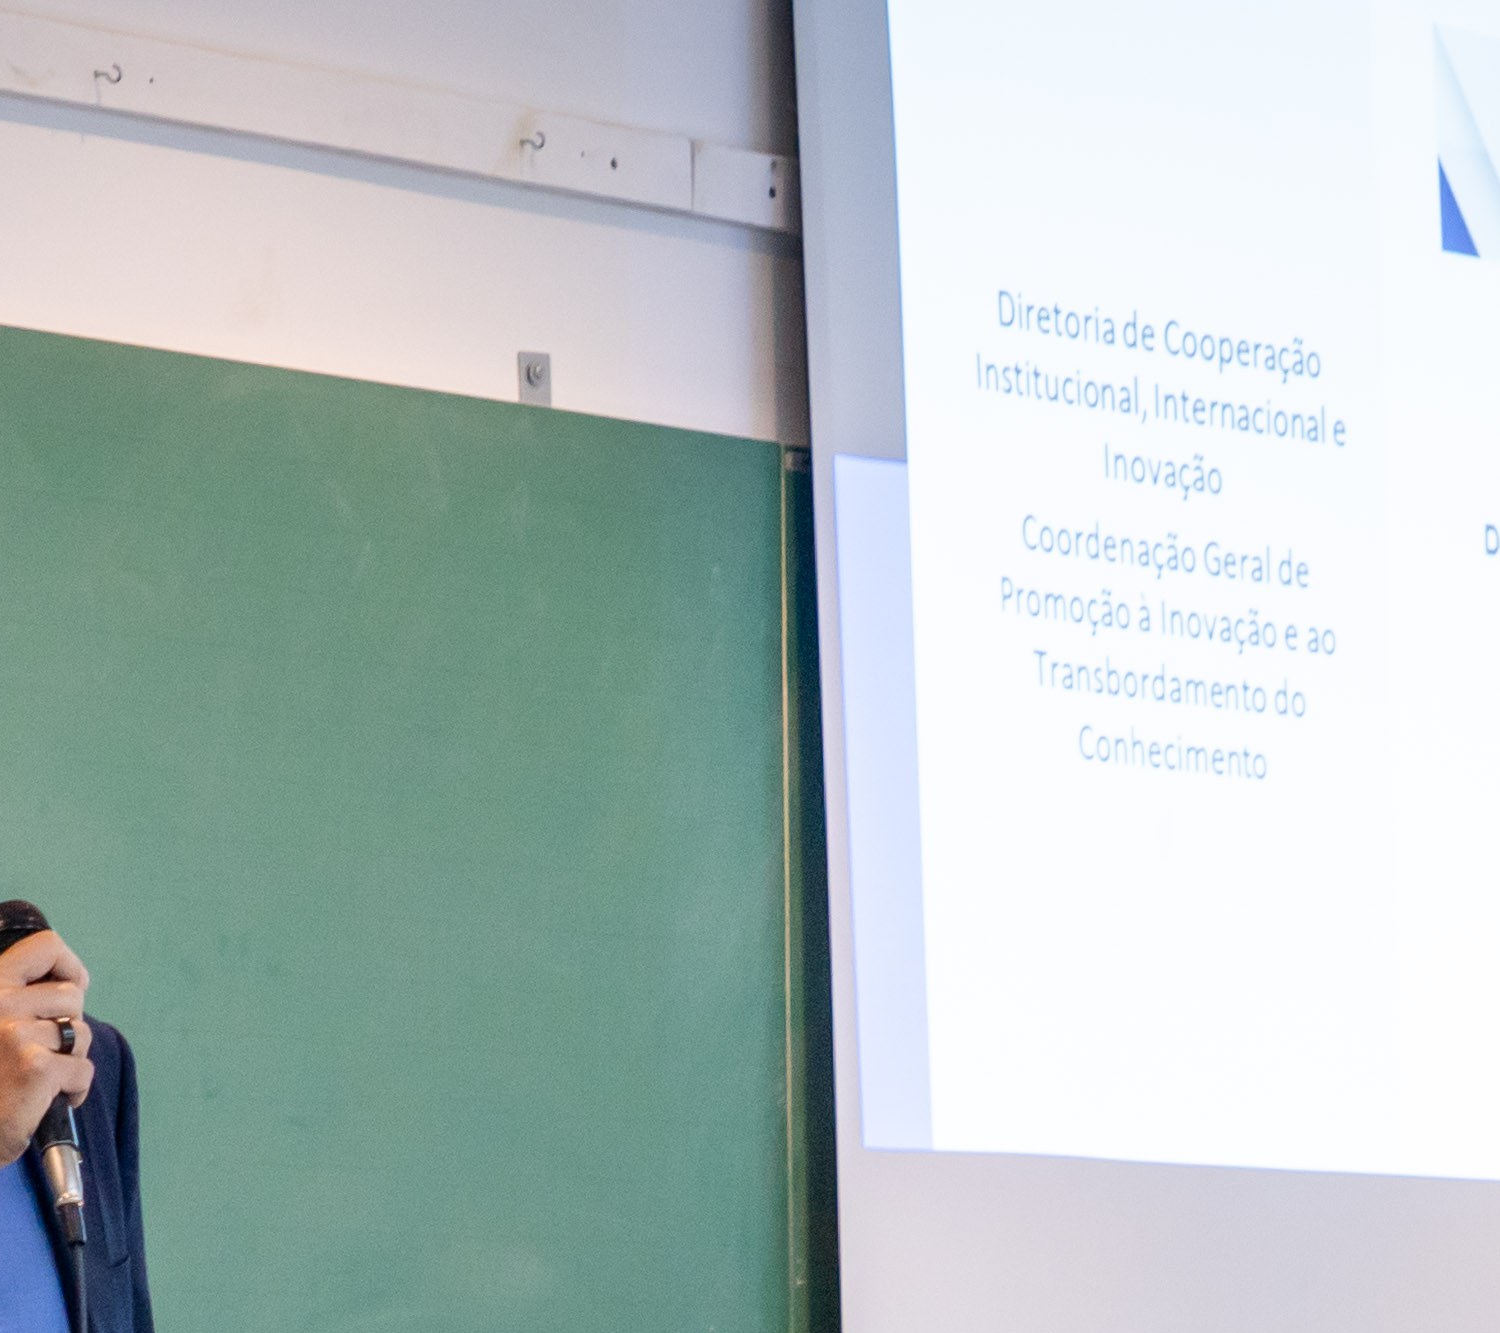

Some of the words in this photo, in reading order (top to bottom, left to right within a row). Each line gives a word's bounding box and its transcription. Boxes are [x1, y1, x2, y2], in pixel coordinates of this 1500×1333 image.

[997, 289, 1117, 347] Diretoria
[1121, 308, 1156, 353] de
[1162, 319, 1322, 385] Cooperação
[975, 351, 1148, 425] Institucional,
[1154, 383, 1326, 444] Internacional
[1331, 418, 1348, 449] e
[1103, 442, 1223, 502] Inovação
[1021, 513, 1197, 581] Coordenação
[1203, 540, 1271, 585] Geral
[1277, 547, 1310, 590] de
[1000, 575, 1131, 637] Promoção
[1138, 594, 1152, 633] à
[1160, 600, 1278, 656] Inovação
[1283, 623, 1299, 652] e
[1306, 626, 1337, 657] ao
[1032, 648, 1267, 714] Transbordamento
[1274, 679, 1307, 720] do
[1078, 723, 1268, 781] Conhecimento
